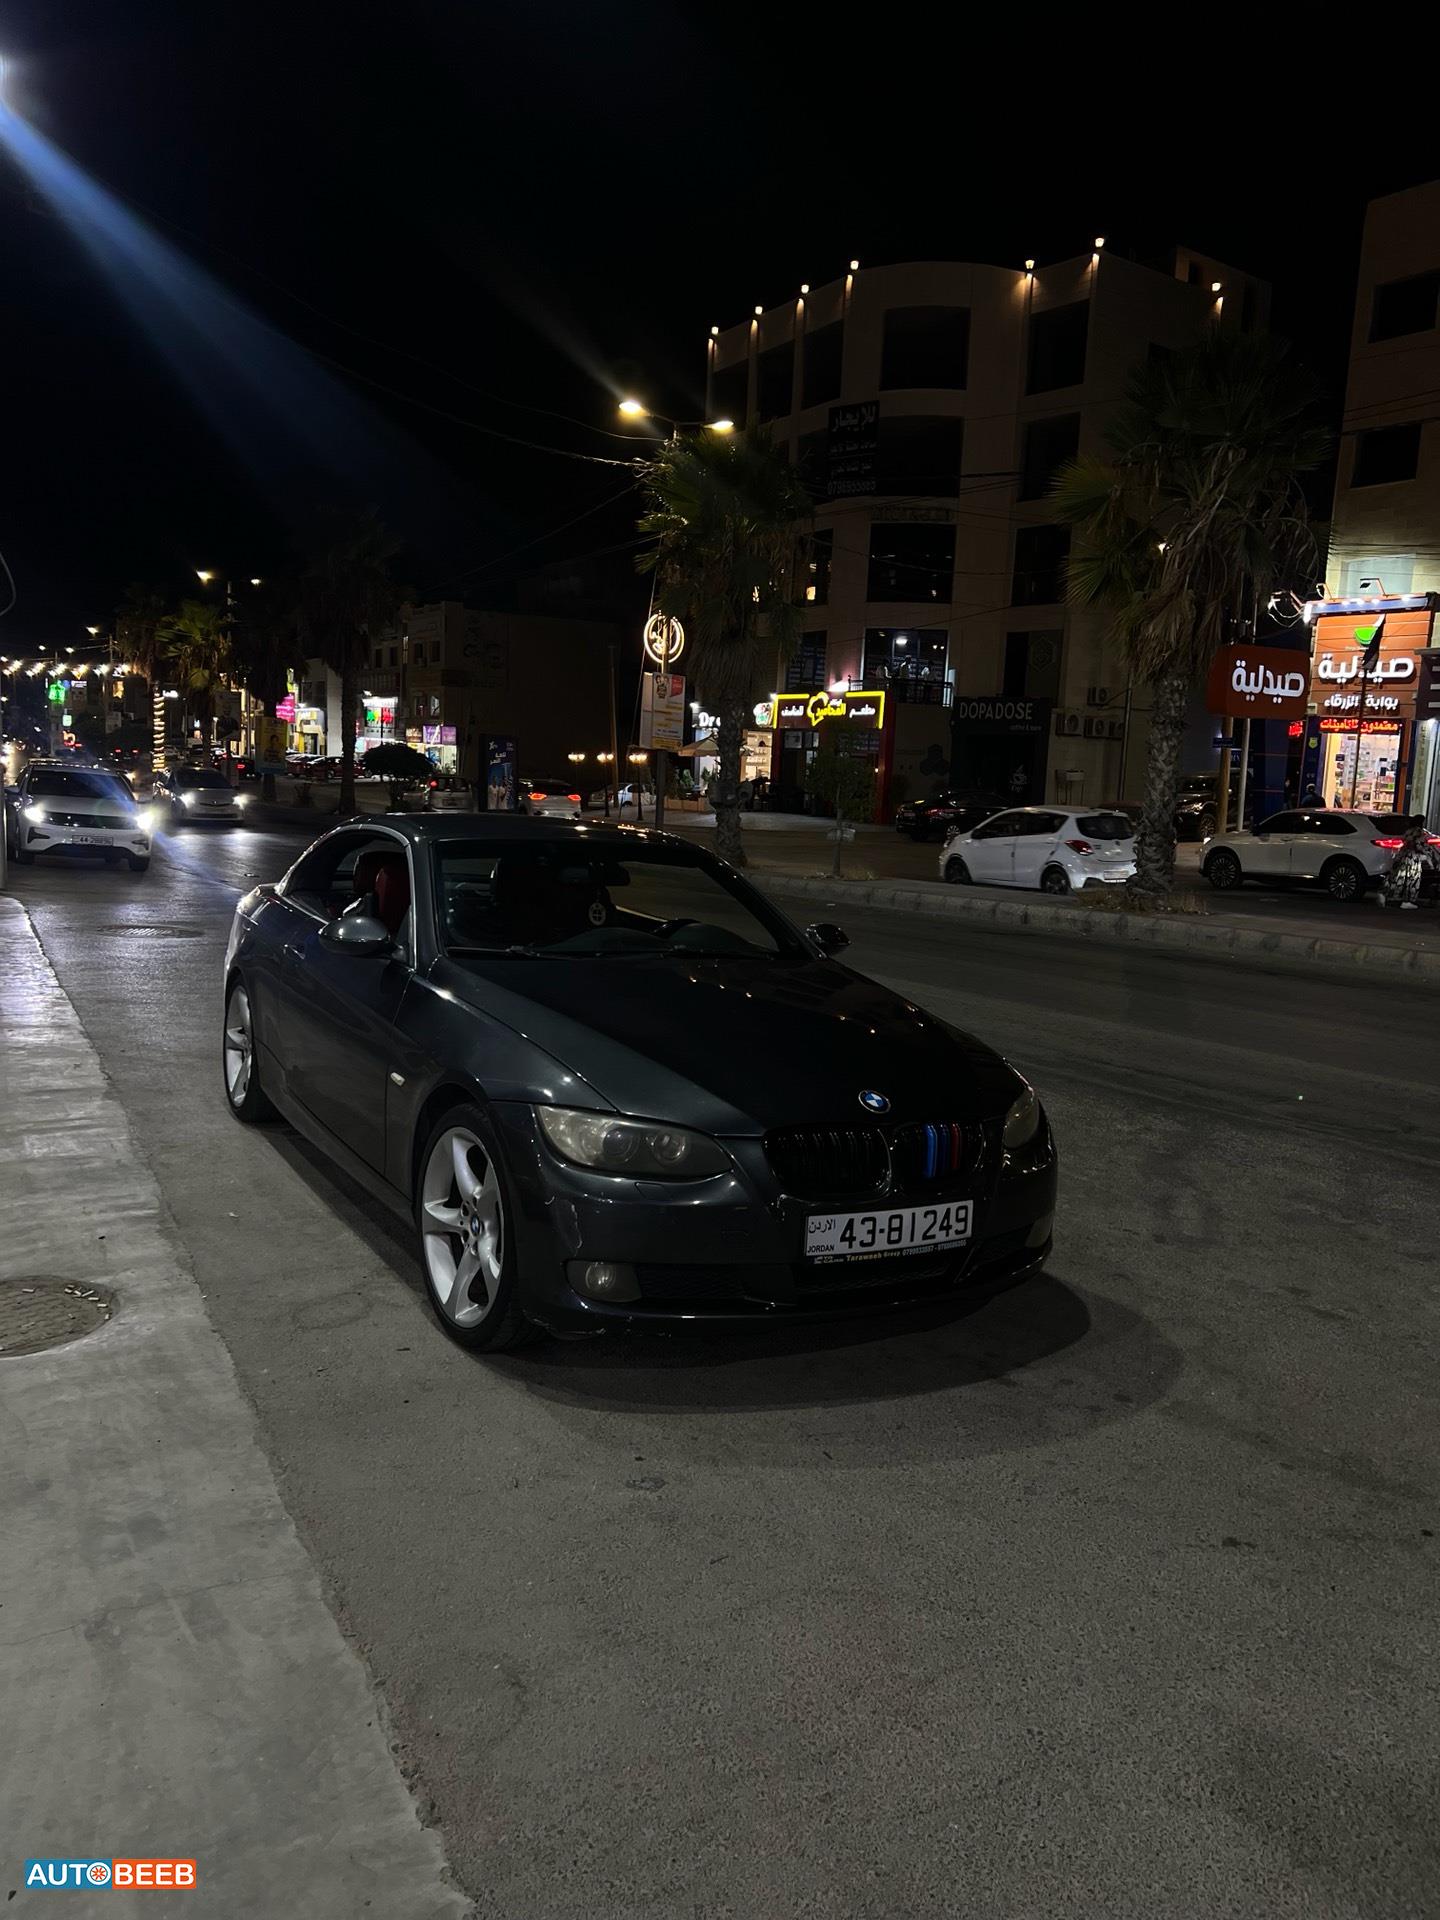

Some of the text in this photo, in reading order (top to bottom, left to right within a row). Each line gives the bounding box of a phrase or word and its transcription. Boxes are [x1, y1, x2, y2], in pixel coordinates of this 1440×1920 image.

[1232, 660, 1305, 704] صيدلية
[1324, 693, 1398, 710] بوابة الزرقاء
[849, 704, 876, 718] مطعم
[960, 702, 1033, 720] DOPADOSE
[840, 1205, 968, 1248] 43-81249
[808, 1244, 835, 1253] JORDAN
